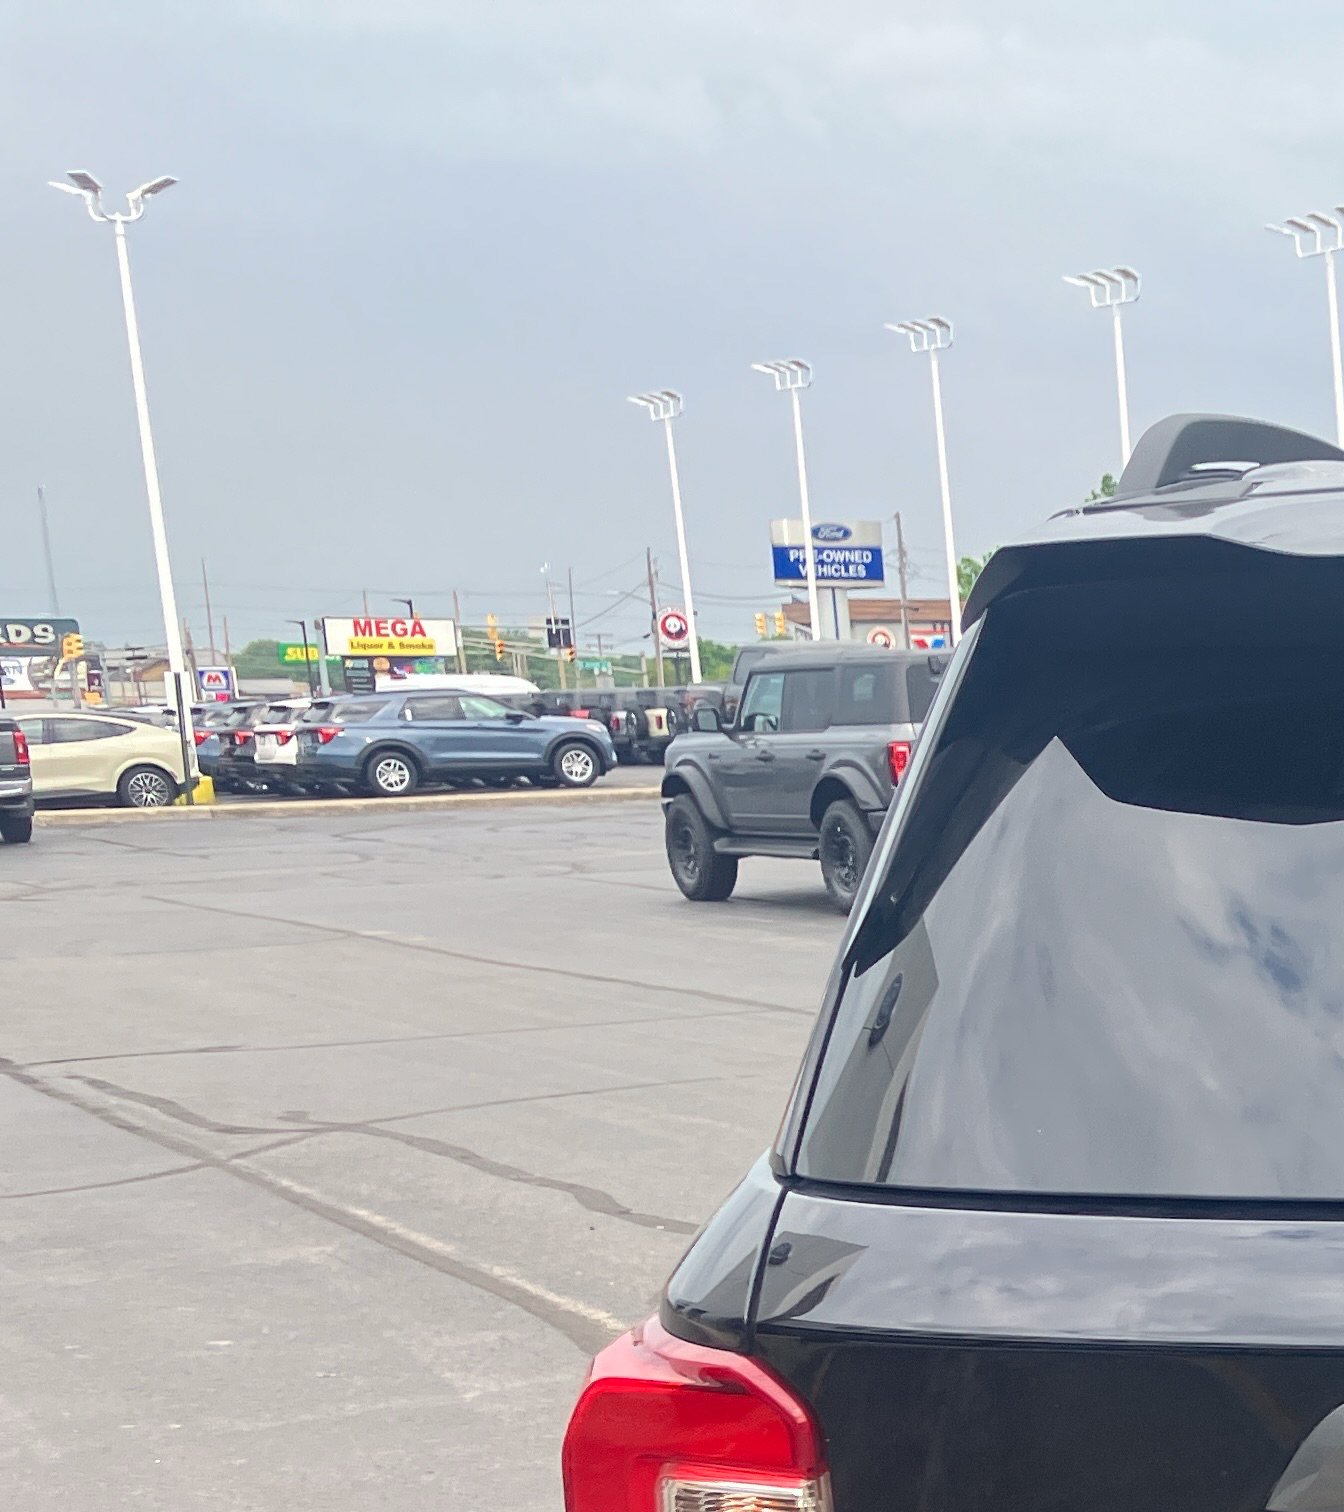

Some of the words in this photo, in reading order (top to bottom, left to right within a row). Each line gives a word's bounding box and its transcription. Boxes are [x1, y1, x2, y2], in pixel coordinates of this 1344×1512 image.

[798, 564, 867, 578] VHICLES
[0, 623, 56, 644] DS
[352, 617, 427, 638] MEGA
